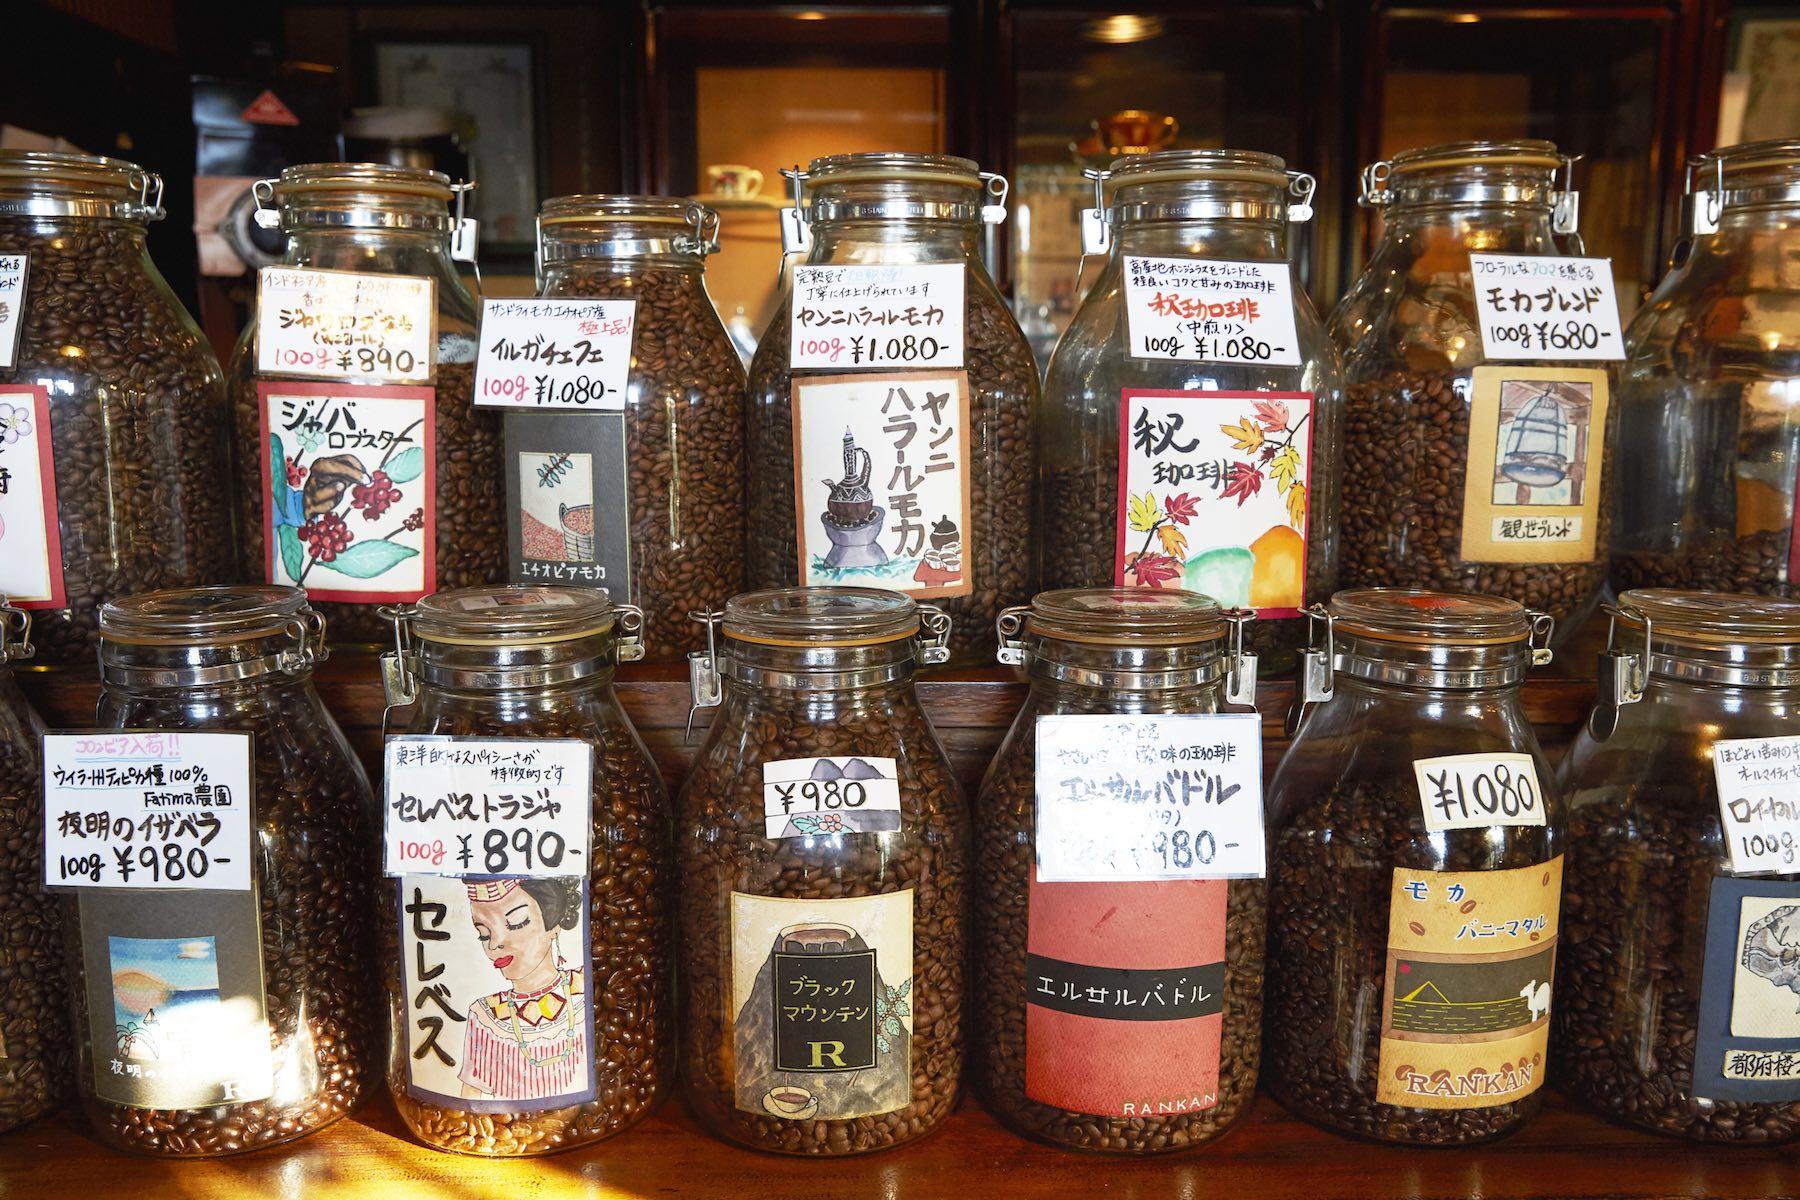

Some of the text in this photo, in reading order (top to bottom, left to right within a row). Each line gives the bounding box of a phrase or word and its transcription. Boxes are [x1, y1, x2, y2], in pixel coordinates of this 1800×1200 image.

[1486, 286, 1603, 313] モカブレンド
[796, 305, 945, 328] ヤンニハラールモカ
[491, 333, 604, 366] イルガチェフェ
[799, 337, 847, 362] 100g
[1144, 335, 1185, 357] 100g
[1490, 323, 1532, 349] 100g
[275, 348, 333, 370] 100g
[483, 375, 530, 402] 100g
[282, 400, 357, 433] ジャバ
[921, 391, 955, 474] ヤンニ
[880, 387, 926, 558] ハラールモカ
[1152, 457, 1237, 491] 珈琲
[521, 562, 606, 580] エチオピアモカ
[490, 764, 566, 785] 特徴的です
[774, 780, 867, 815] ¥980
[57, 810, 221, 847] 夜明のイザベラ
[399, 839, 448, 866] 100g
[1742, 831, 1798, 865] 100g
[60, 853, 106, 883] 100g
[1456, 915, 1547, 939] バニーマタル
[405, 887, 467, 1067] セレベス
[789, 975, 856, 997] ブラック
[1036, 976, 1212, 1007] エルサルバドル
[783, 1004, 869, 1023] マウンテン
[807, 1040, 847, 1068] R
[1728, 1052, 1800, 1078] 都府楼
[1405, 1063, 1534, 1097] RANKAN
[1123, 1092, 1217, 1116] RANKAN
